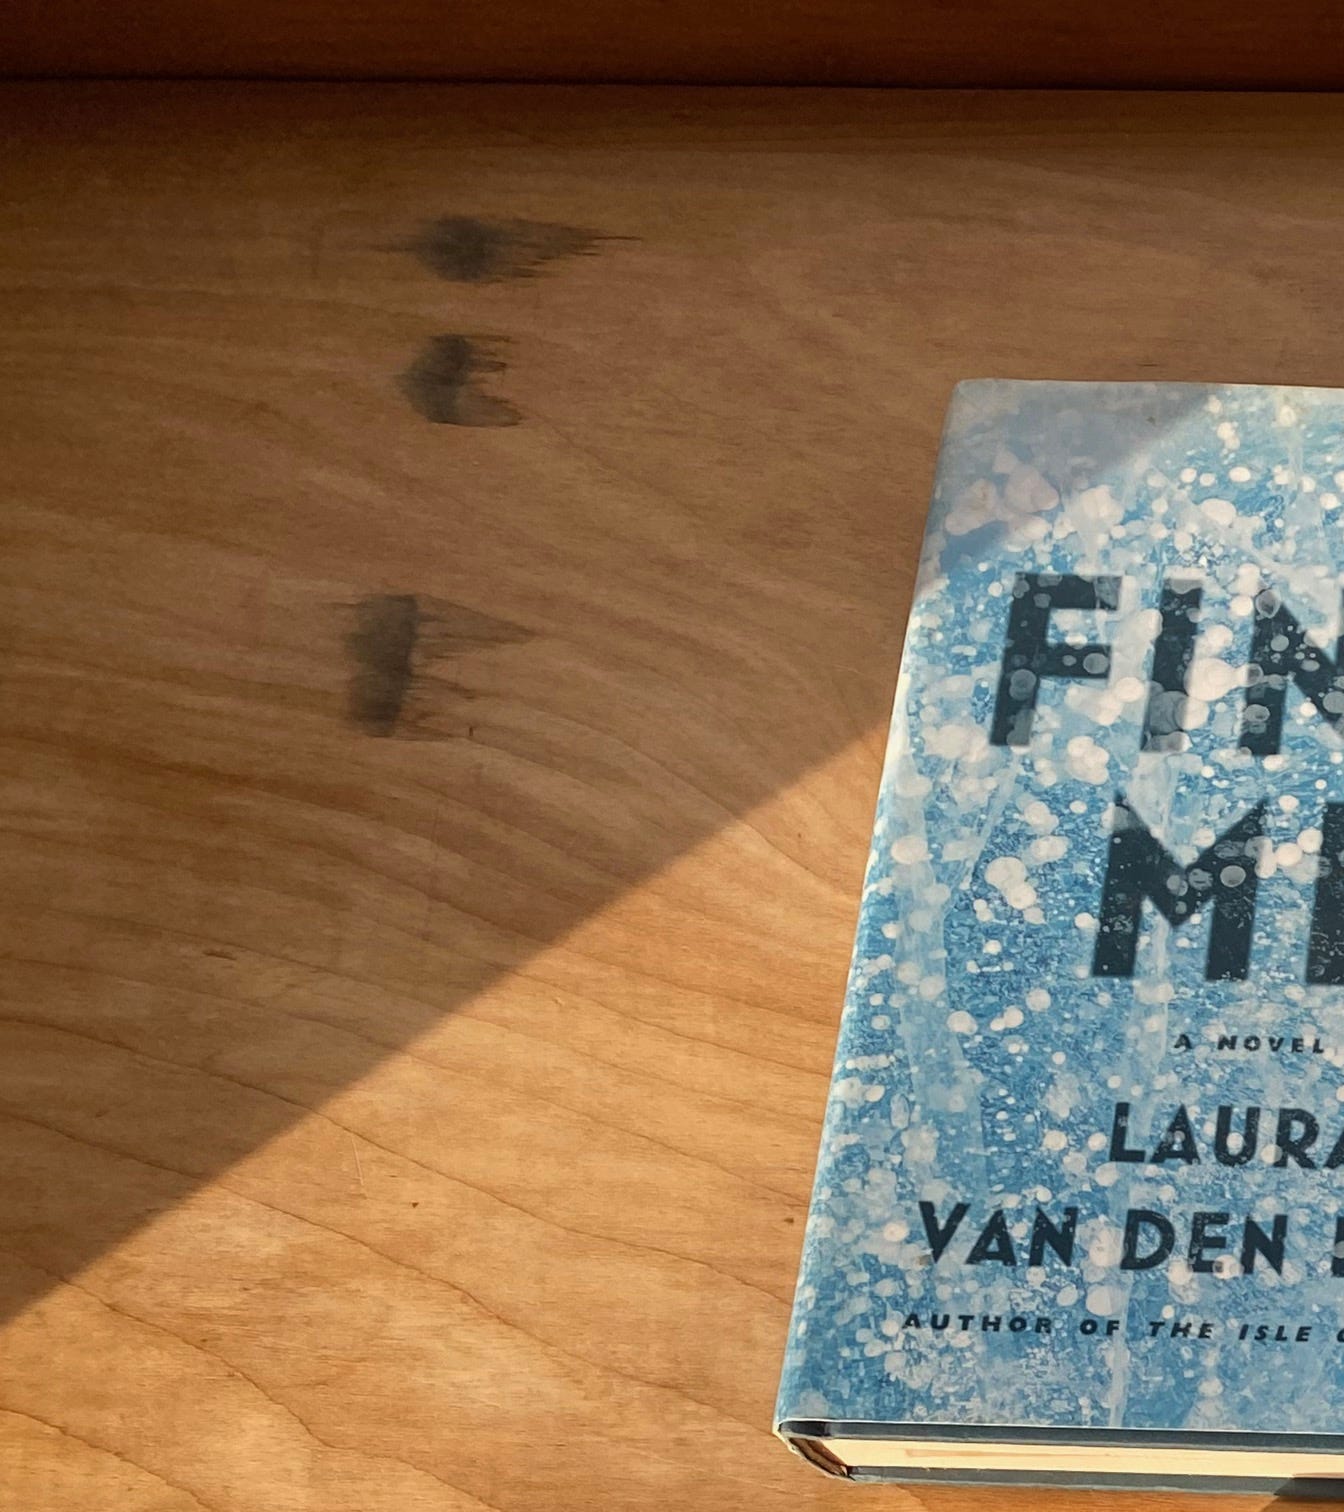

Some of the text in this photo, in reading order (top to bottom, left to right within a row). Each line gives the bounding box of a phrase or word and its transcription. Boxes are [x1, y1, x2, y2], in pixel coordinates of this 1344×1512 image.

[1173, 1033, 1327, 1055] A NOVEL
[919, 1200, 1078, 1268] VAN
[1121, 1208, 1288, 1275] DEN
[903, 1313, 1055, 1335] AUTHOR
[1079, 1318, 1122, 1338] OF
[1149, 1321, 1215, 1341] THE
[1239, 1323, 1311, 1344] ISLE
